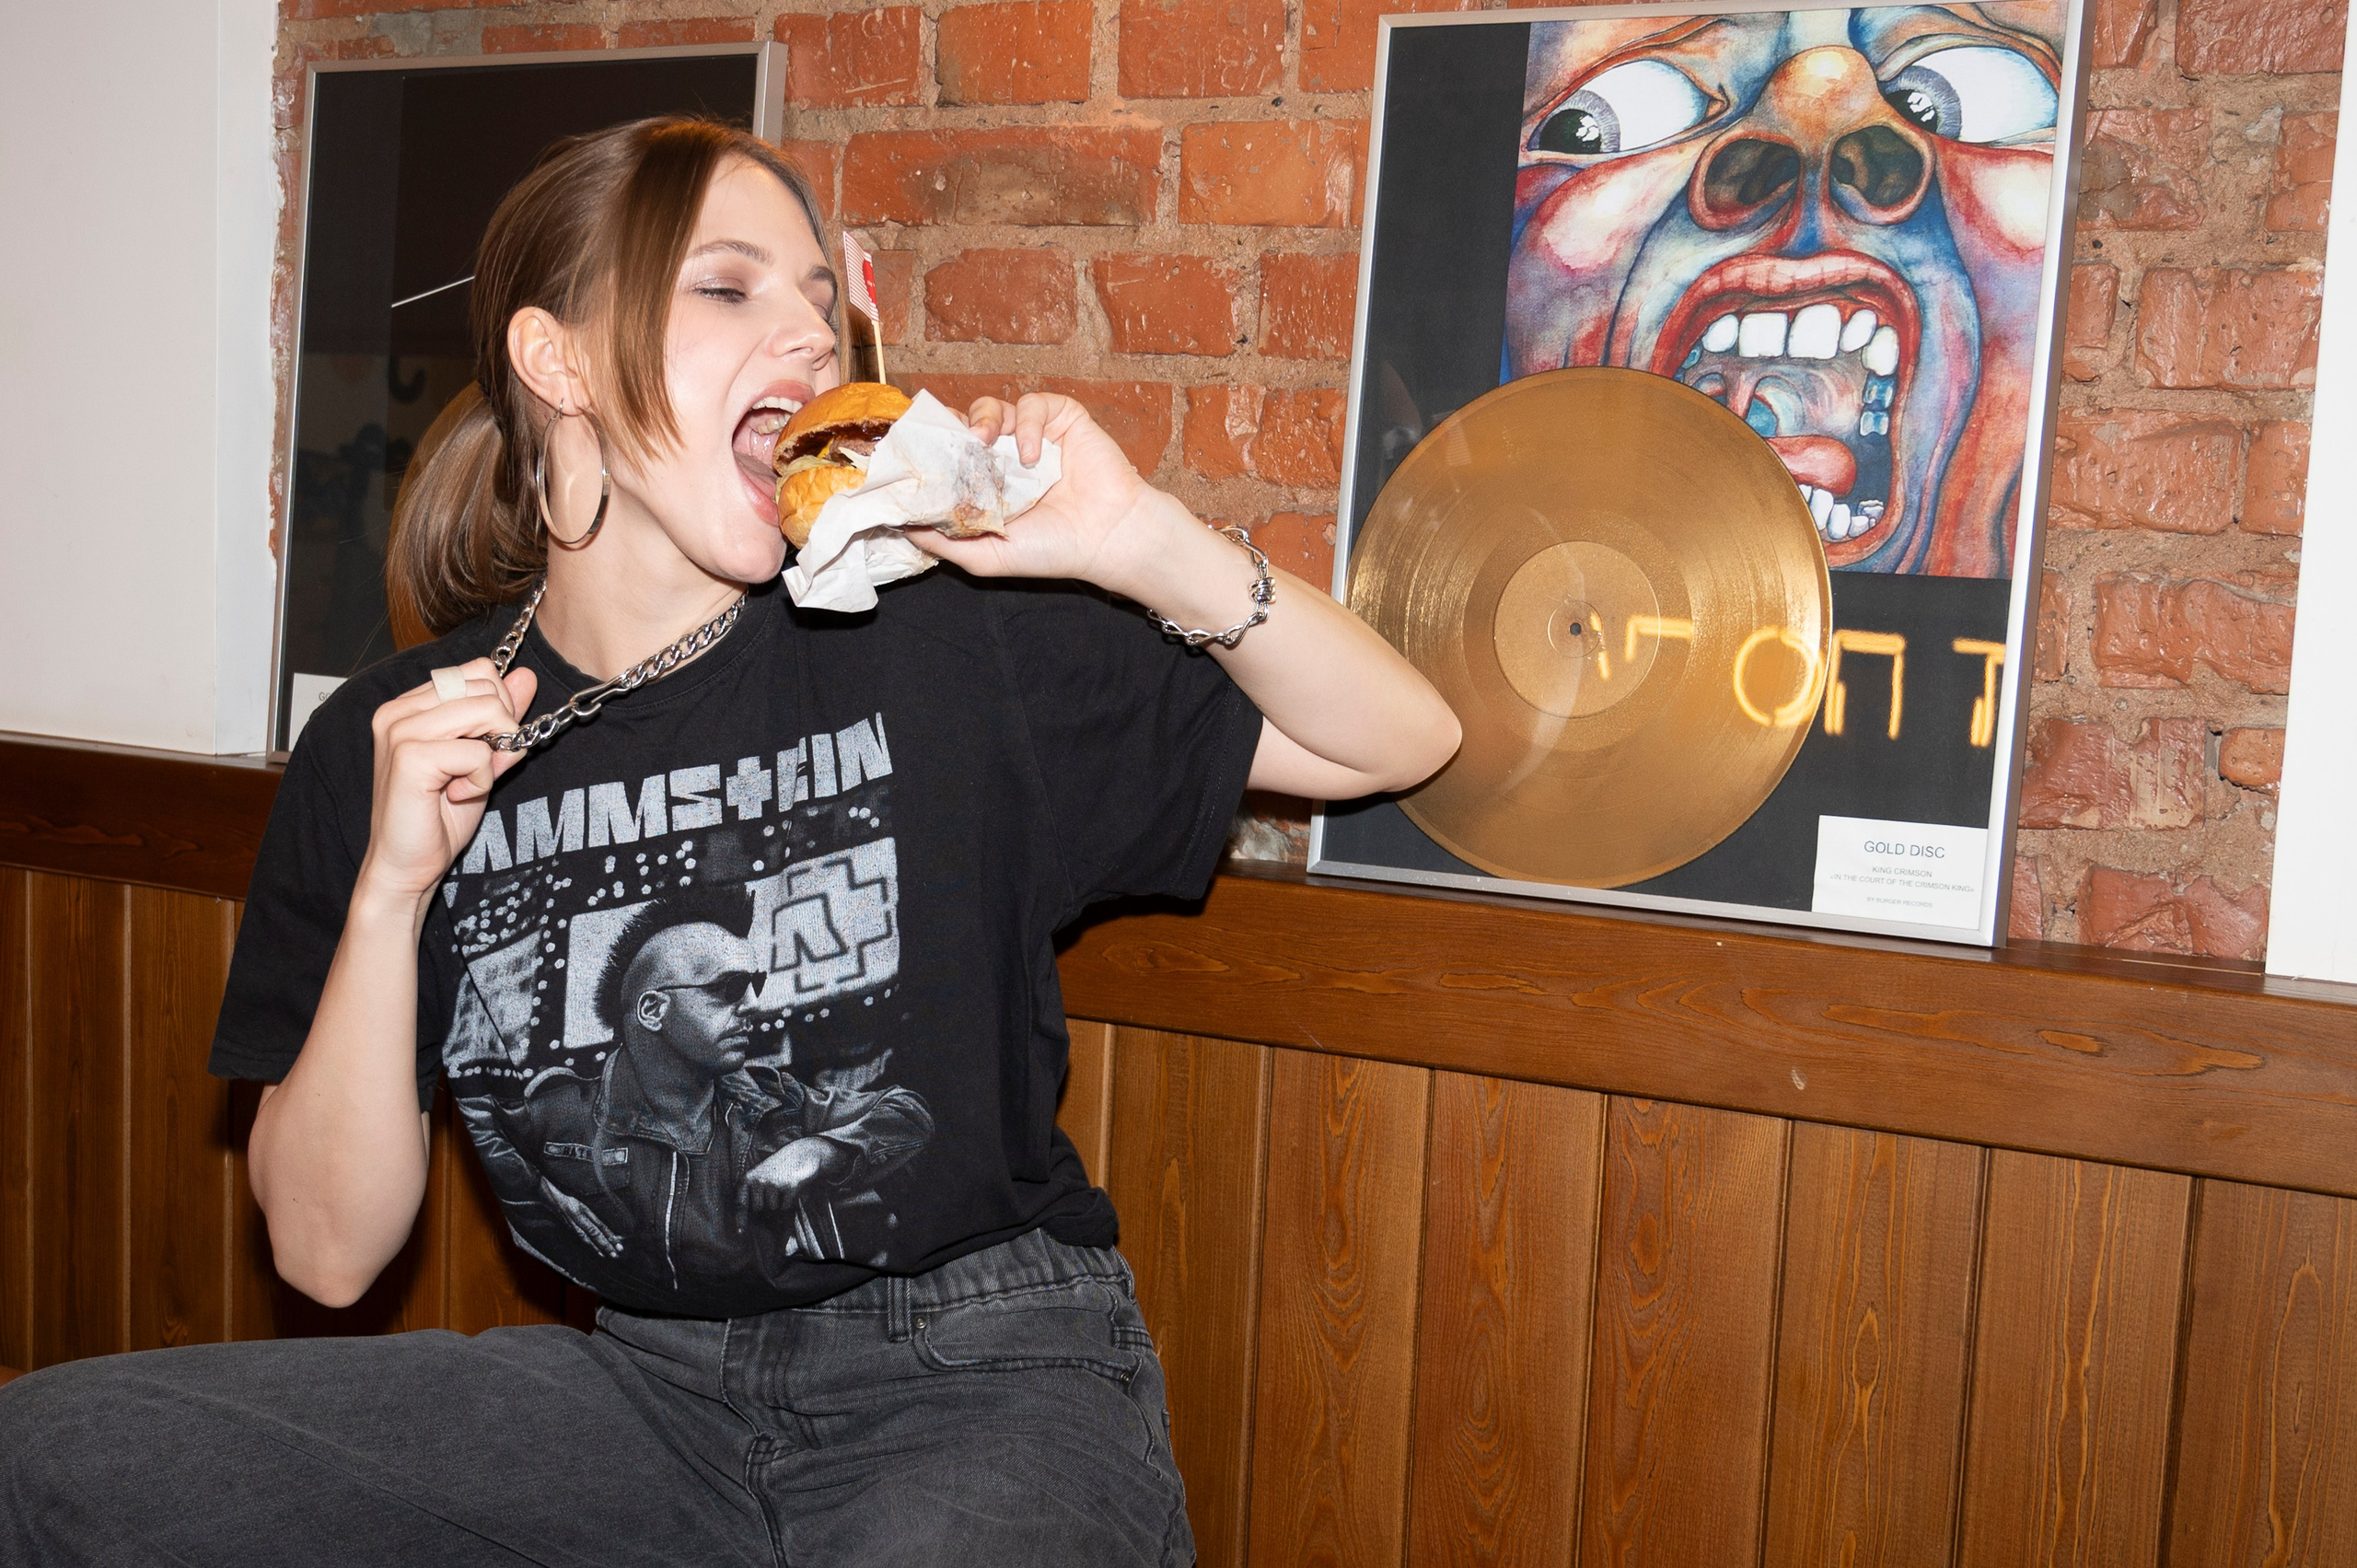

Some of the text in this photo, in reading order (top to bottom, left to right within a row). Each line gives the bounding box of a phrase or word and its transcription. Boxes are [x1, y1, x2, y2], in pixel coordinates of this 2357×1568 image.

[450, 712, 893, 876] AMMSTEIN
[1864, 840, 1945, 859] GOLD DISC
[1872, 865, 1933, 877] KING CRIMSON
[1859, 876, 1885, 884] COURT
[1915, 881, 1950, 890] CRIMSON
[1875, 897, 1902, 905] BURGER
